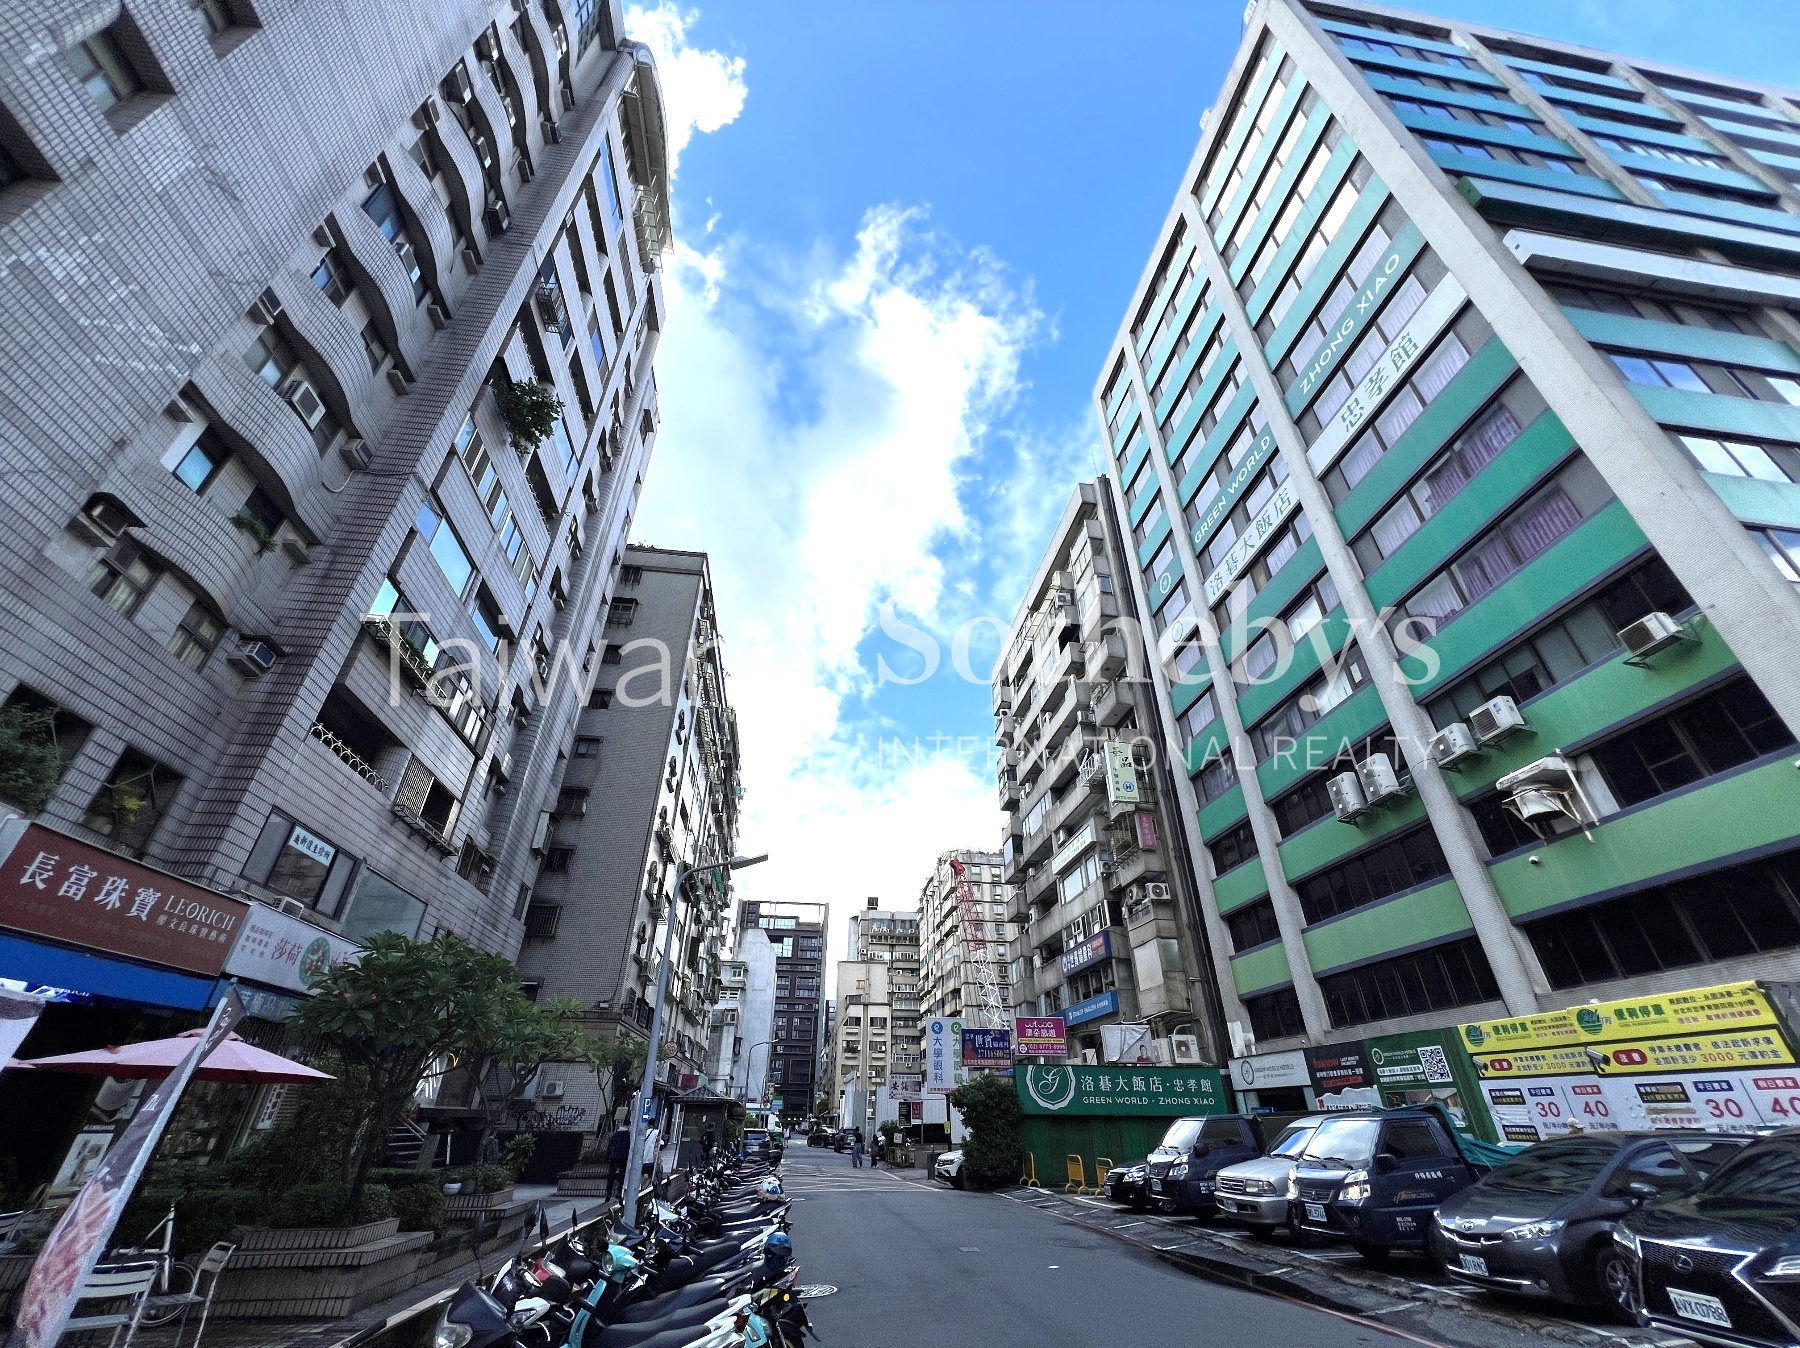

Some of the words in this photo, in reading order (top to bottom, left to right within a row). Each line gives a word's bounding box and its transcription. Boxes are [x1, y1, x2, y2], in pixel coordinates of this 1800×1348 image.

[1300, 318, 1355, 396] ZHONG
[1356, 254, 1400, 316] XIAO
[1341, 331, 1419, 433] 忠孝館
[1194, 496, 1227, 544] GREEN
[1227, 435, 1271, 494] WORLD
[1209, 487, 1292, 596] 洛碁大飯店
[20, 851, 161, 921] 長富珠寶
[164, 895, 237, 931] LEORICH
[271, 937, 303, 966] 莎荷
[1614, 1004, 1666, 1021] 便利停車
[1492, 1022, 1530, 1036] 便利停車
[932, 1037, 943, 1083] 大學眼科
[1546, 1062, 1567, 1070] 3000
[1618, 1051, 1643, 1064] 注意
[1654, 1054, 1698, 1066] 並加計至少
[1700, 1051, 1735, 1063] 3000
[1737, 1049, 1783, 1061] 元違約金
[1697, 1081, 1730, 1091] 平日費率
[1757, 1079, 1796, 1089] 假日費率
[644, 1098, 651, 1113] P
[1082, 1096, 1113, 1105] GREEN
[1115, 1096, 1148, 1105] WORLD
[1159, 1096, 1191, 1105] ZHONG
[1193, 1096, 1215, 1105] XIAO
[1583, 1100, 1609, 1118] 40
[1705, 1098, 1744, 1118] 30
[1535, 1101, 1561, 1118] 30
